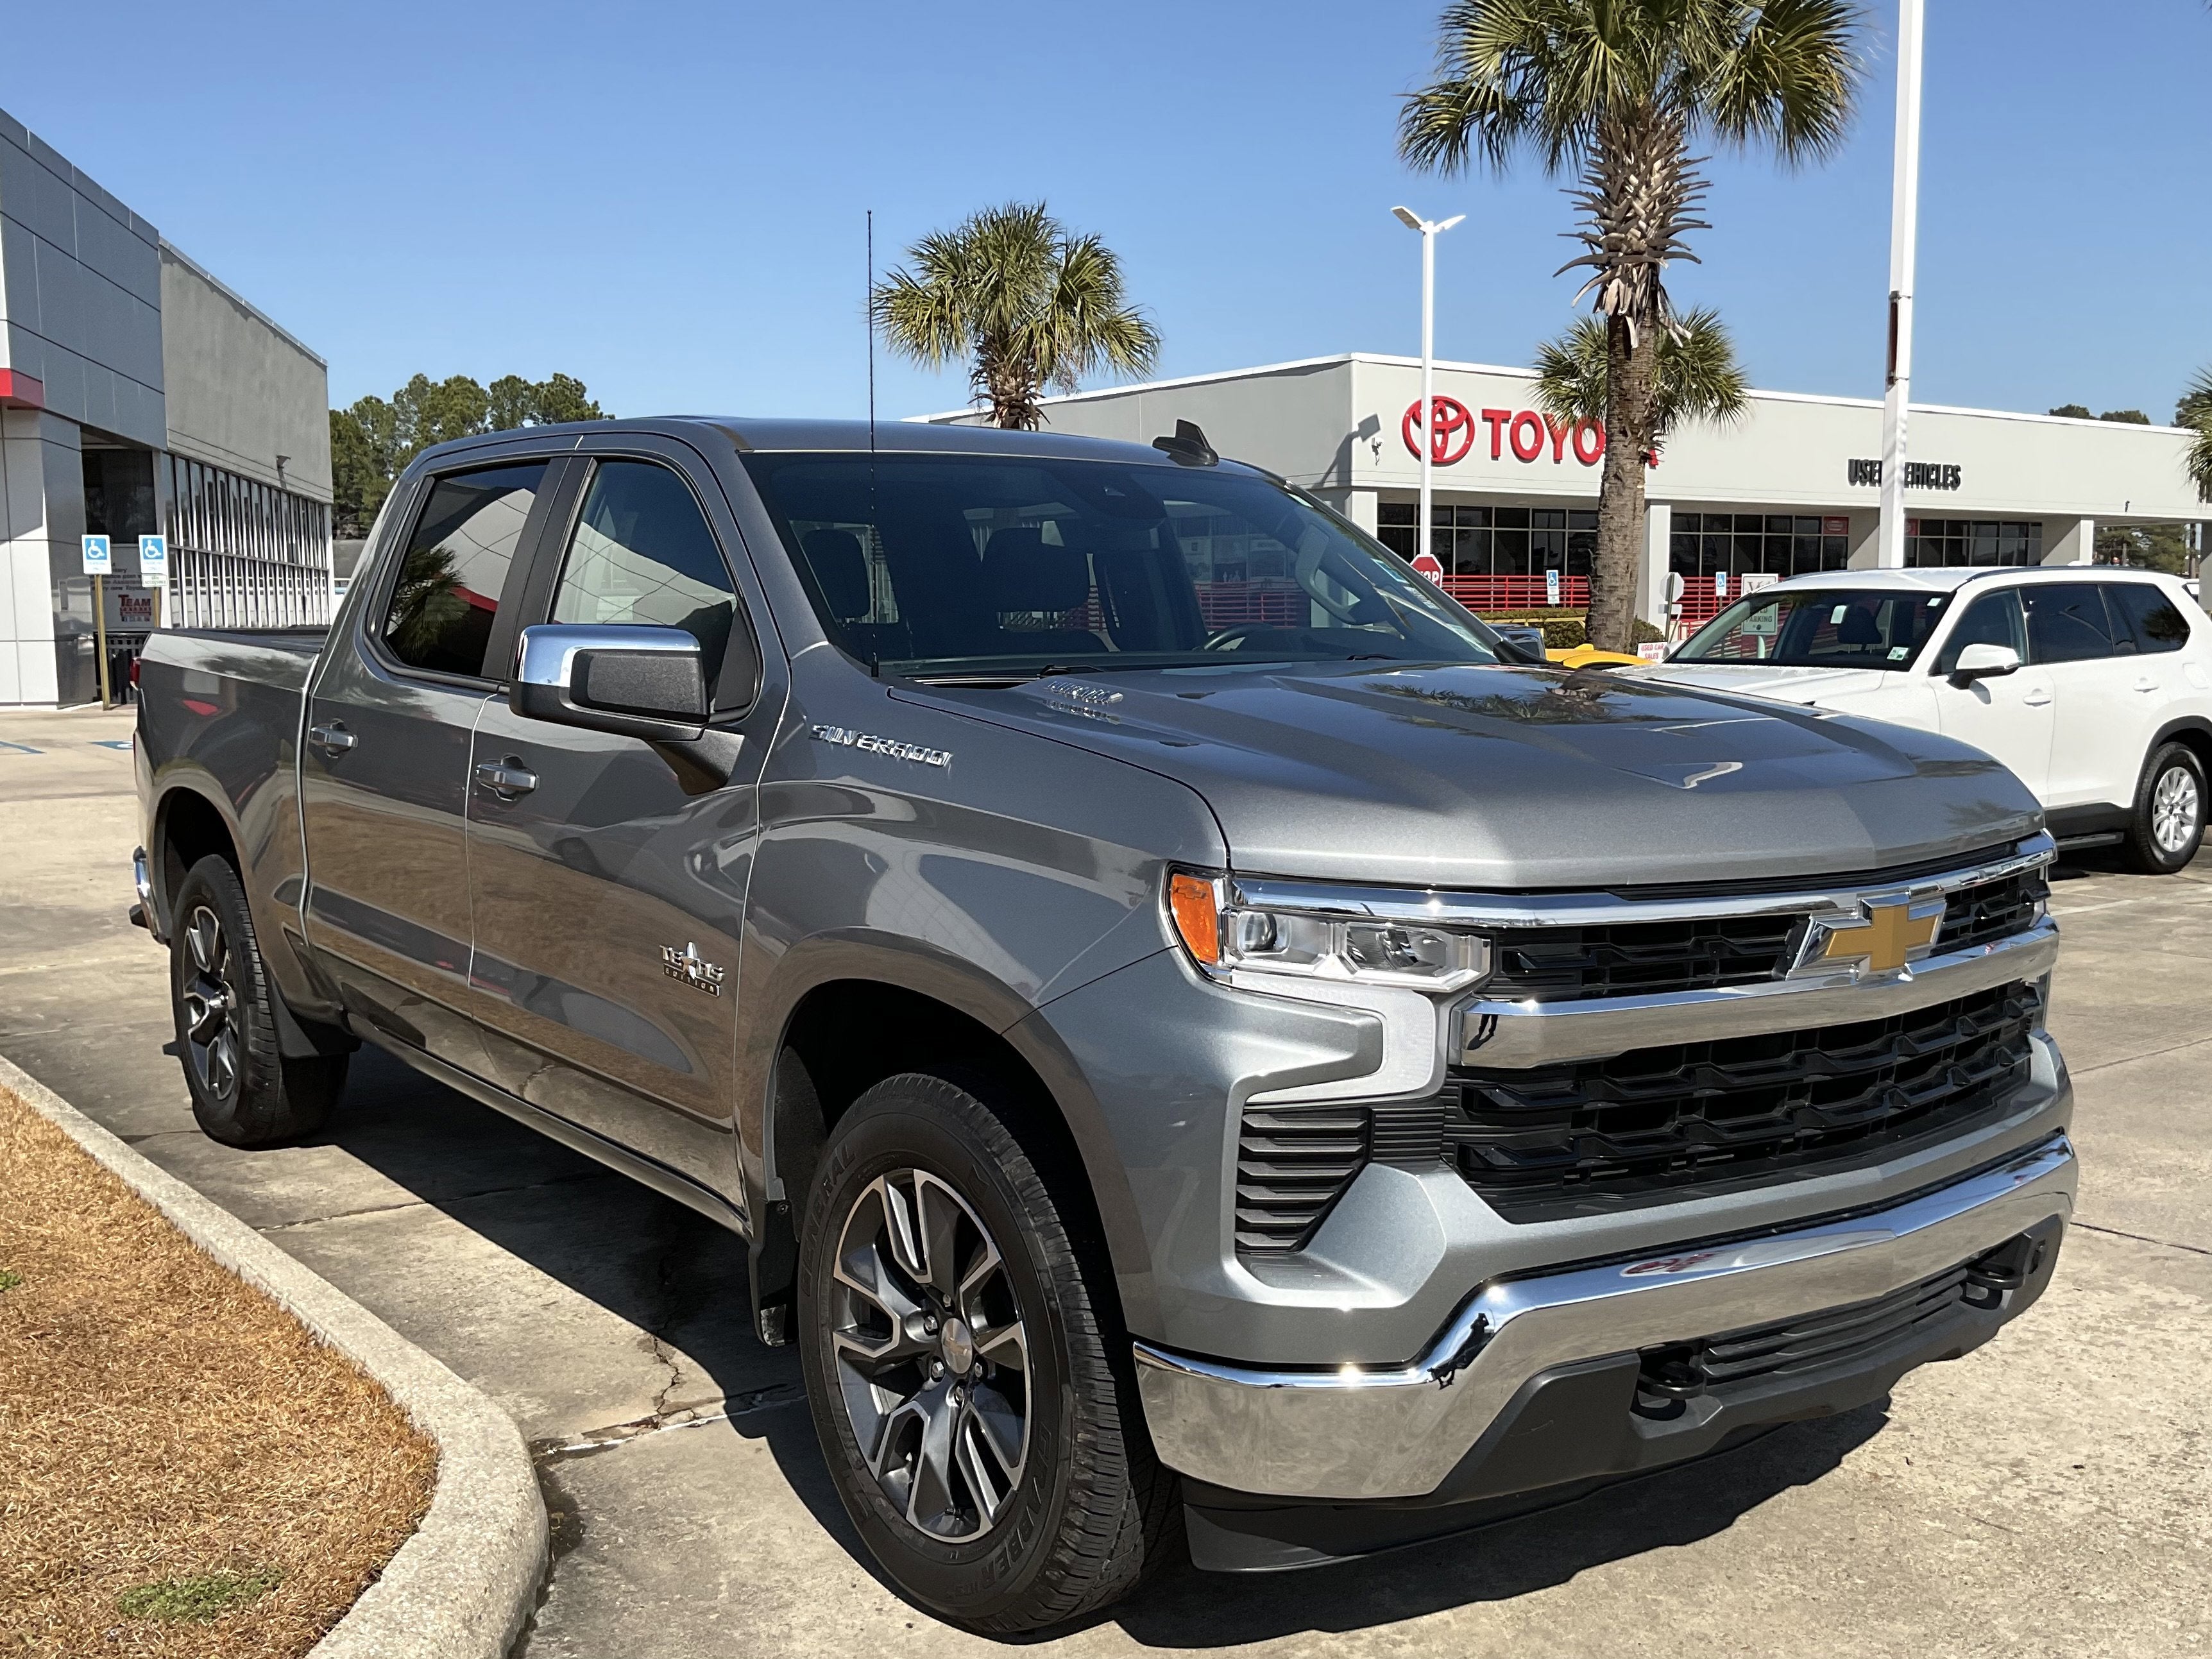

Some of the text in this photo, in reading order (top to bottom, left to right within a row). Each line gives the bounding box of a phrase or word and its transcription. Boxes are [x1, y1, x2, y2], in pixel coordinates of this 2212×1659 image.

[1481, 408, 1659, 469] TOYO
[1848, 459, 1961, 491] USE EHICLES
[809, 724, 953, 768] SILVERADO
